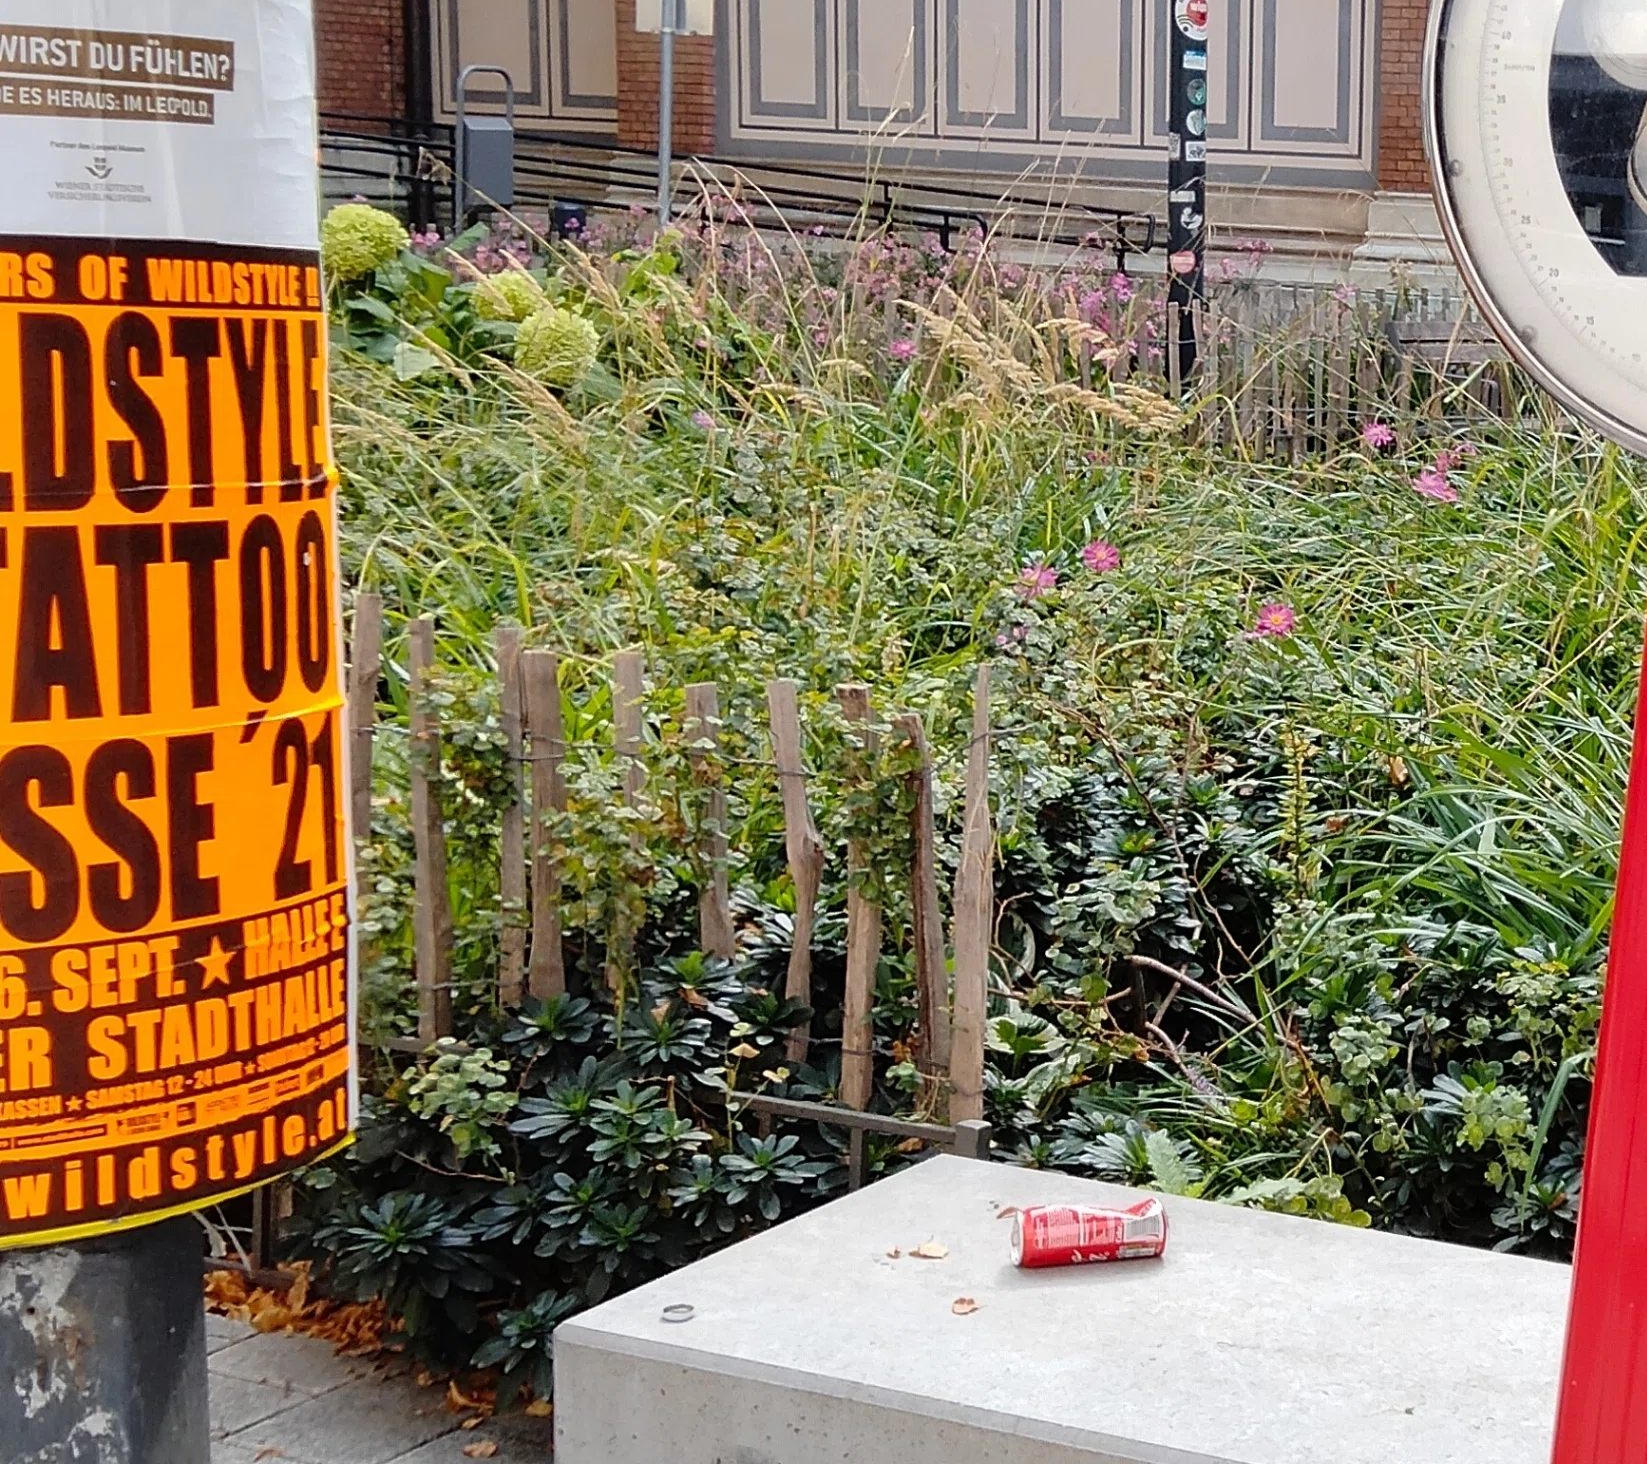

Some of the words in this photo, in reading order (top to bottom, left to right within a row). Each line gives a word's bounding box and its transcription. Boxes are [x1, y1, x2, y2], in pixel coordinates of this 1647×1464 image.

[0, 34, 82, 68] WIRST
[89, 42, 123, 71] DU
[130, 39, 230, 82] FÜHLEN?
[19, 86, 42, 105] ES
[47, 88, 120, 111] HERAUS:
[124, 94, 142, 112] IM
[146, 95, 212, 118] LEOPOLD.
[1521, 215, 1531, 224] 25
[79, 254, 128, 301] OF
[146, 258, 301, 307] WILDSTYLE
[1549, 267, 1559, 277] 20
[51, 935, 186, 1013] SEPT.
[87, 958, 345, 1080] STADTHALLE
